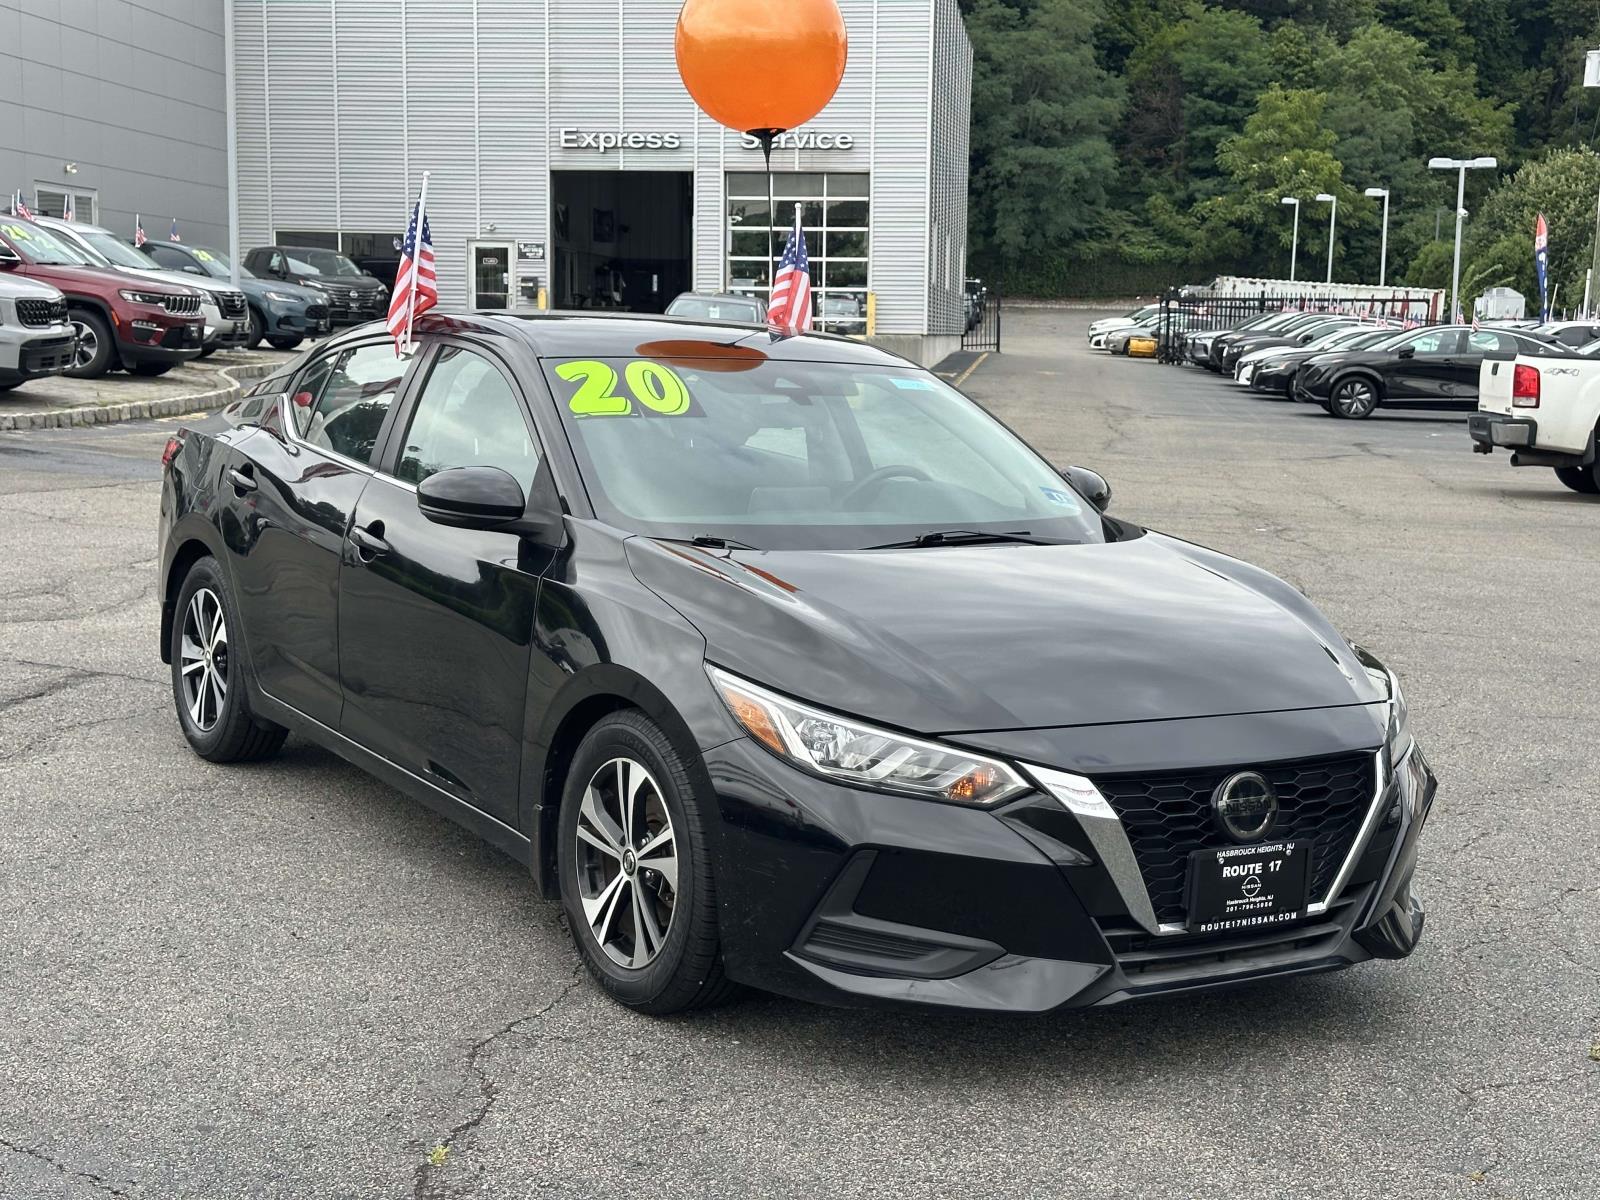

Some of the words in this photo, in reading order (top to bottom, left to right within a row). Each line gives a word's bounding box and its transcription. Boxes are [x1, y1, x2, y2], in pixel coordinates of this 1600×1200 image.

[560, 127, 681, 153] Express
[555, 360, 691, 416] 20
[1217, 848, 1256, 858] HASBROUCK
[1286, 842, 1295, 850] NJ
[1223, 863, 1263, 877] ROUTE
[1269, 860, 1282, 872] 17
[1200, 912, 1297, 932] ROUTE17NISSAN.COM
